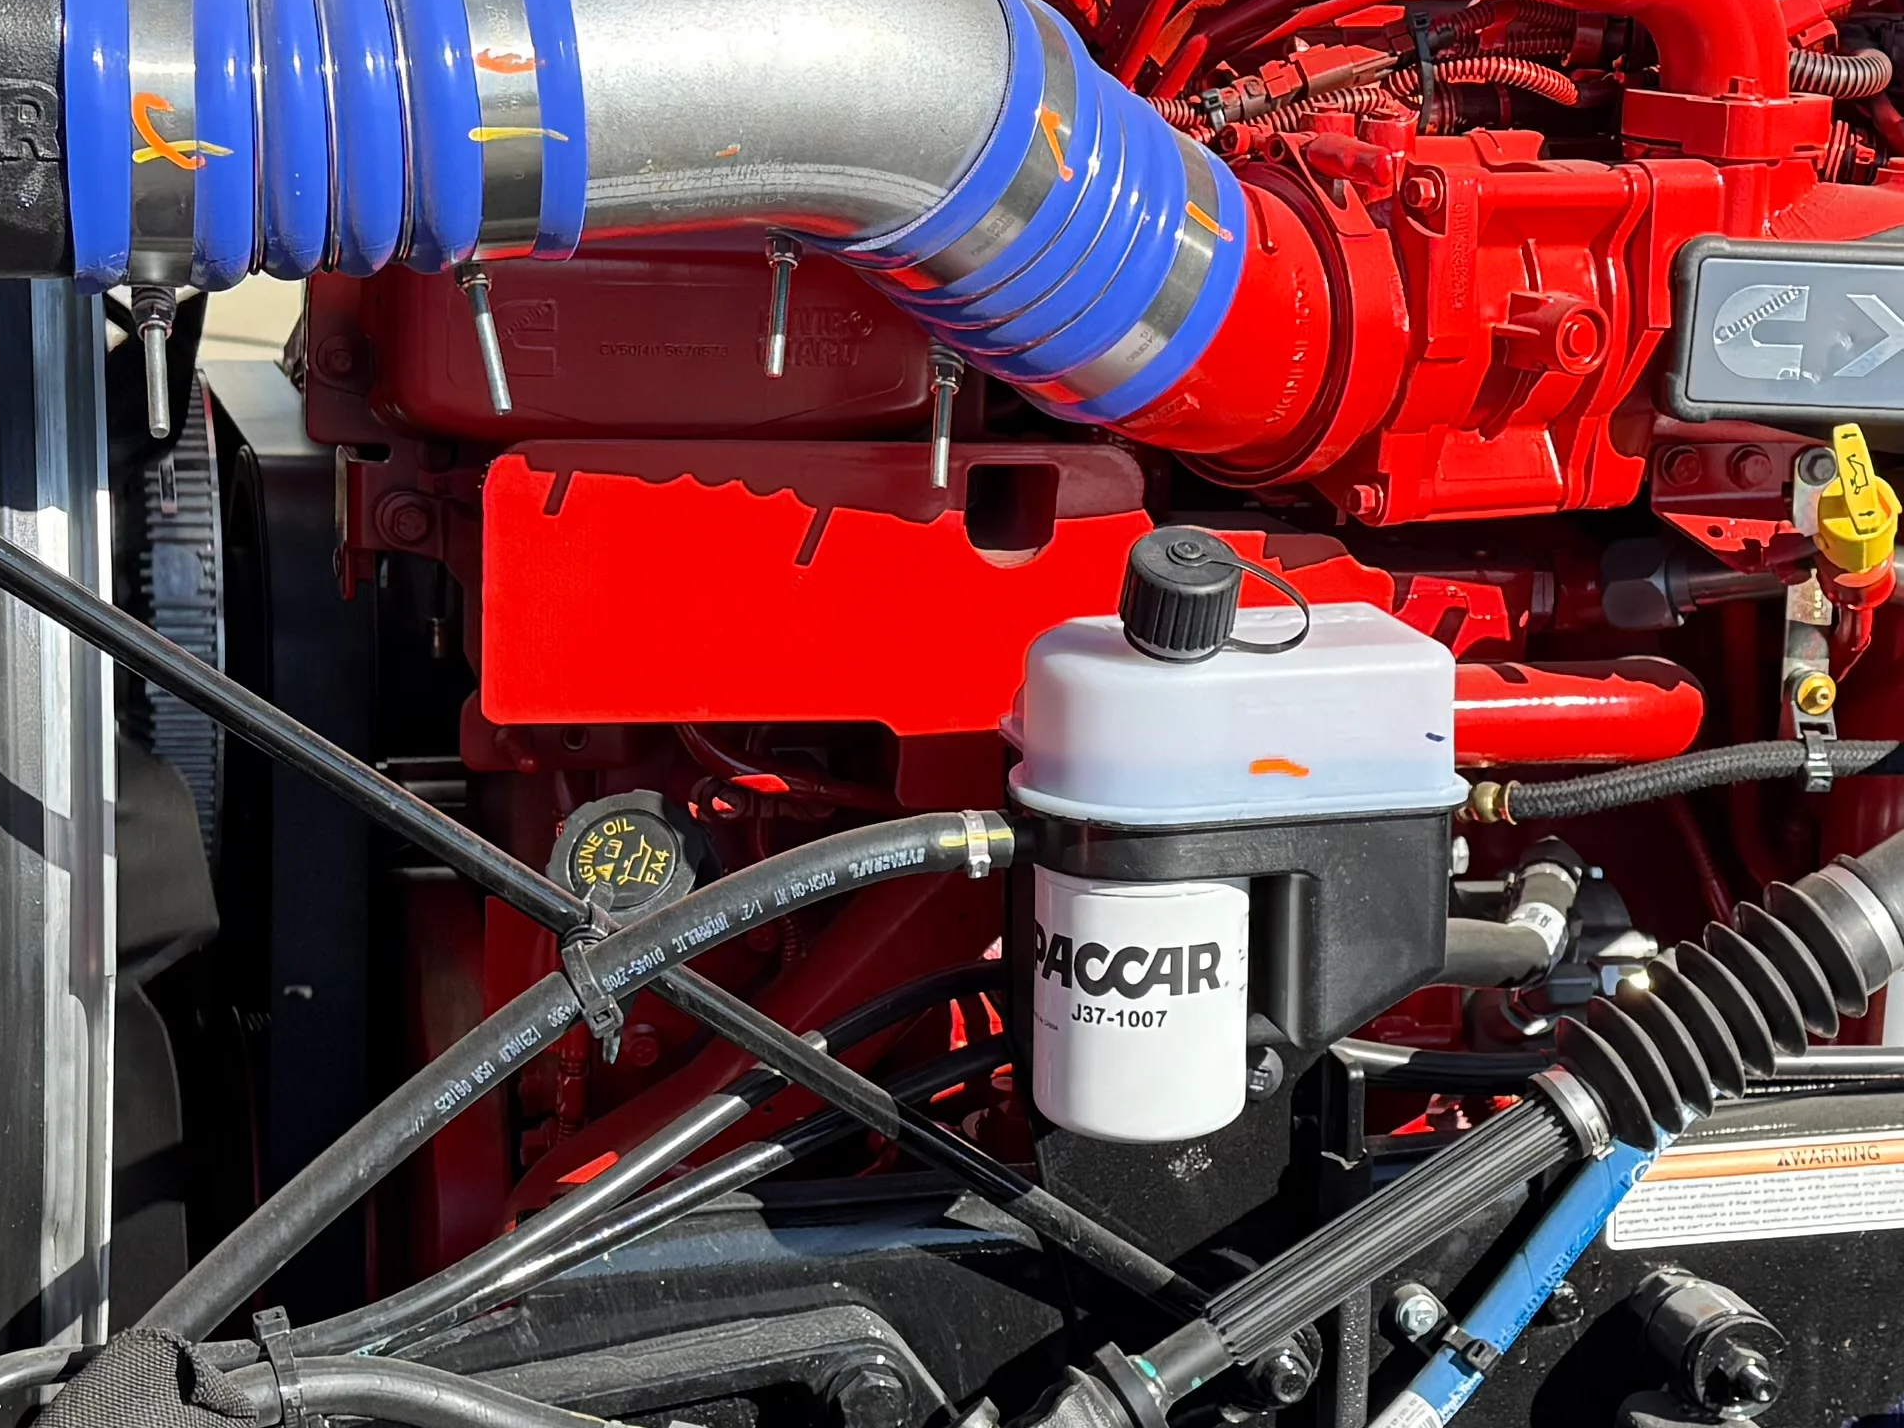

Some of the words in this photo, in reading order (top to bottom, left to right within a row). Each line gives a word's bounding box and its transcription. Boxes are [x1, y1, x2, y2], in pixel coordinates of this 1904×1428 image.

[603, 818, 636, 836] OIL
[646, 849, 670, 885] FA4
[1033, 918, 1222, 1000] PACCAR
[1071, 1002, 1168, 1031] J37-1007
[1790, 1145, 1880, 1165] WARNING
